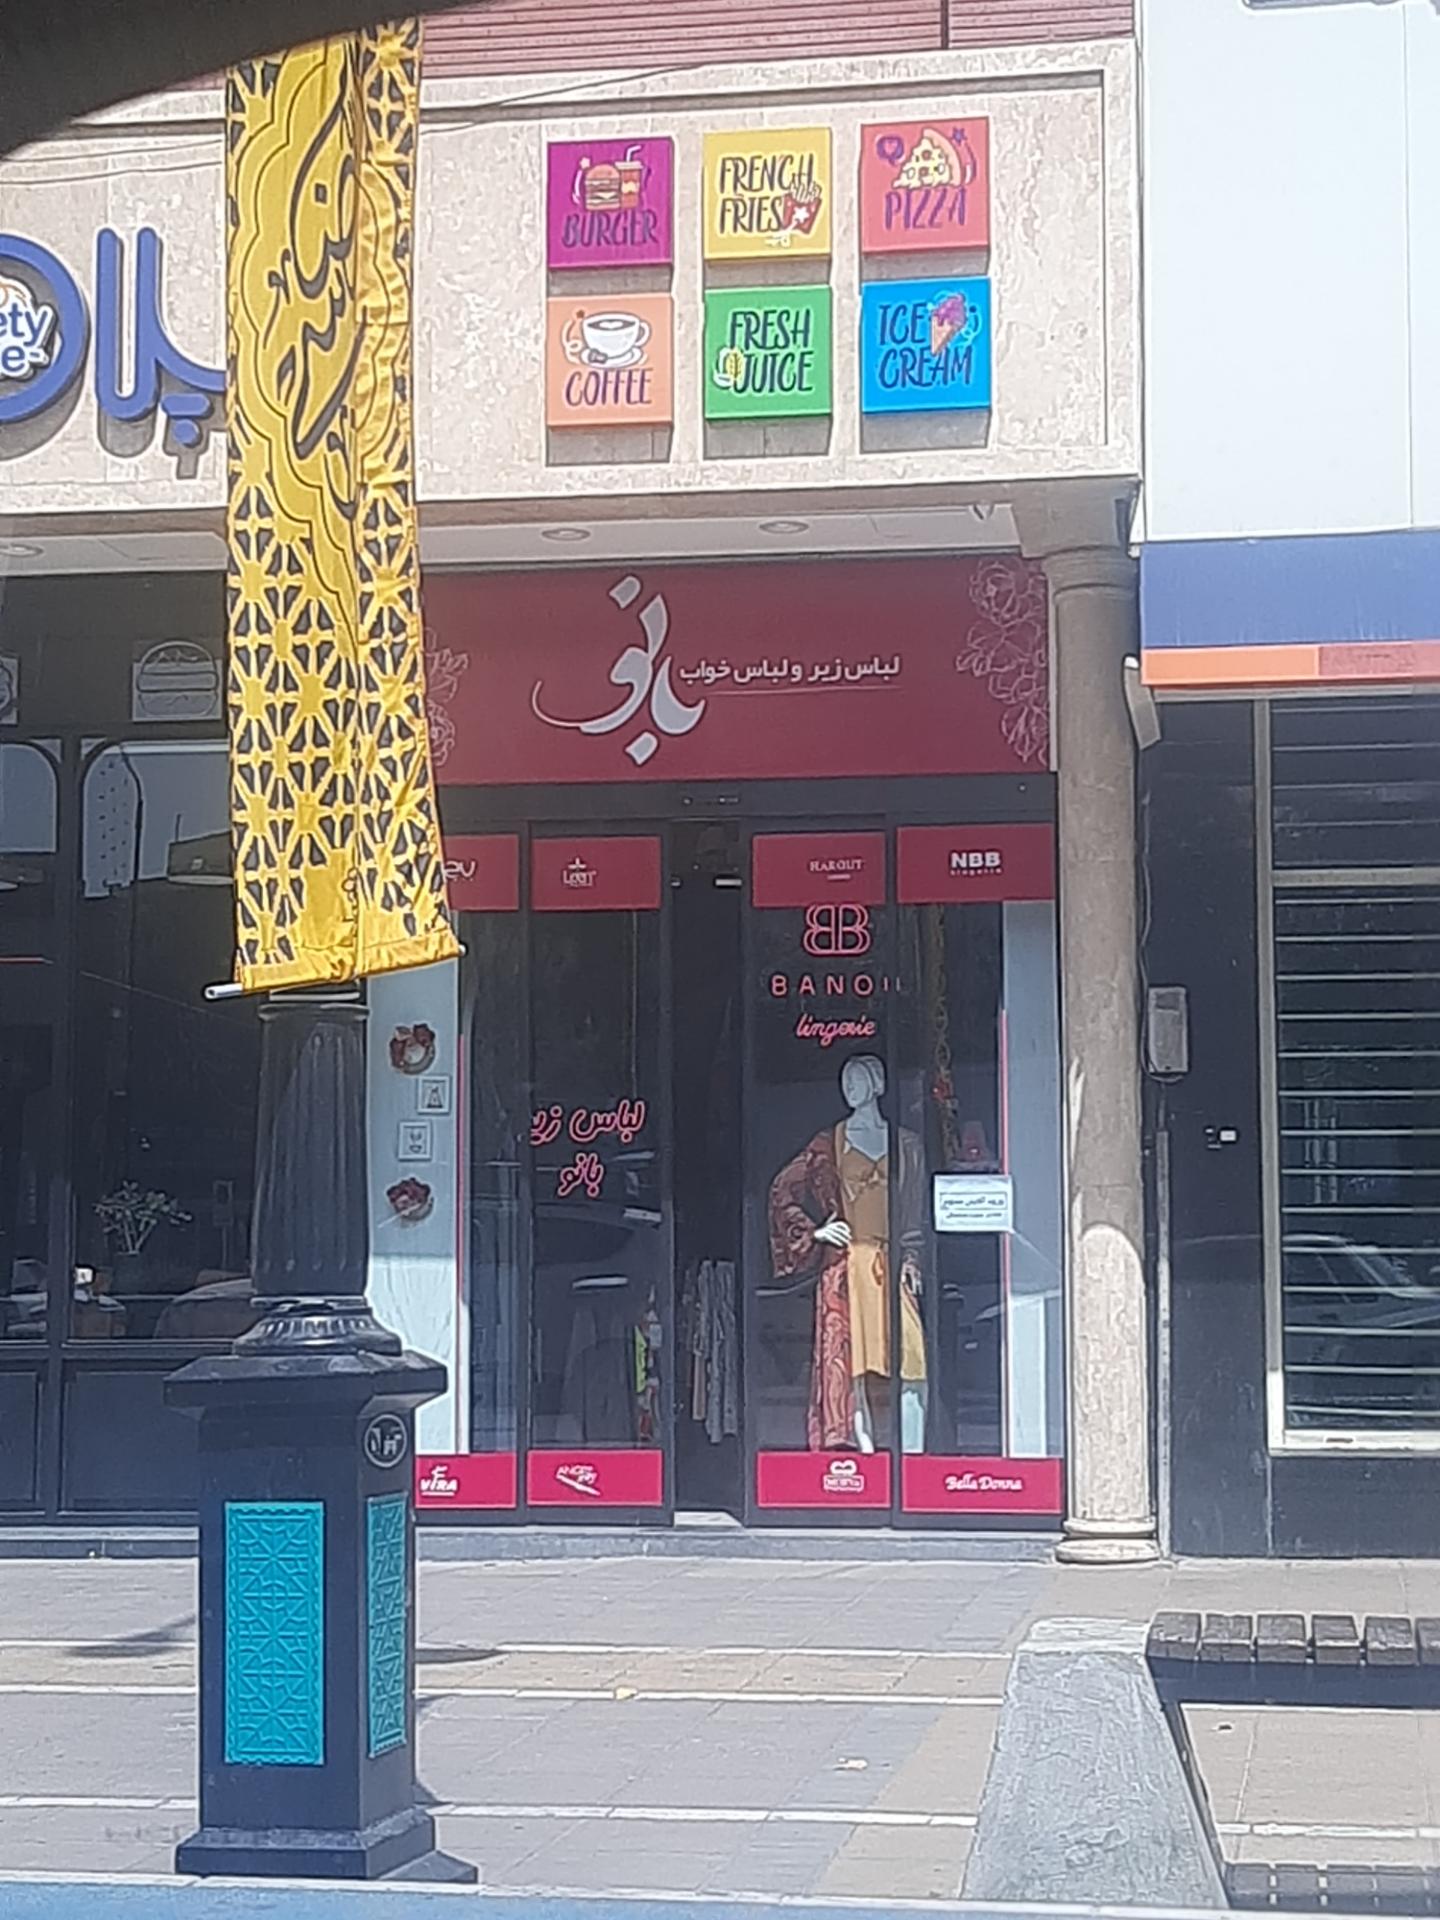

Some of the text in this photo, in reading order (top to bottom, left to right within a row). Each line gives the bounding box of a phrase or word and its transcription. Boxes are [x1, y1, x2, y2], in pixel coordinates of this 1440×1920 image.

[718, 153, 815, 195] FRENCH
[562, 208, 658, 248] BURGER
[718, 197, 783, 235] FRIES
[884, 186, 967, 230] PIZZA
[728, 308, 811, 351] FRESH
[878, 303, 928, 345] ICE
[565, 367, 653, 407] COFFEE
[732, 350, 814, 395] JUICE
[878, 345, 974, 390] CREAM
[679, 656, 900, 685] لباس زیر و لباس خواب
[951, 852, 1001, 868] NBB
[569, 1099, 645, 1143] لباس
[558, 1152, 604, 1198] بانو
[945, 1474, 977, 1491] Bella
